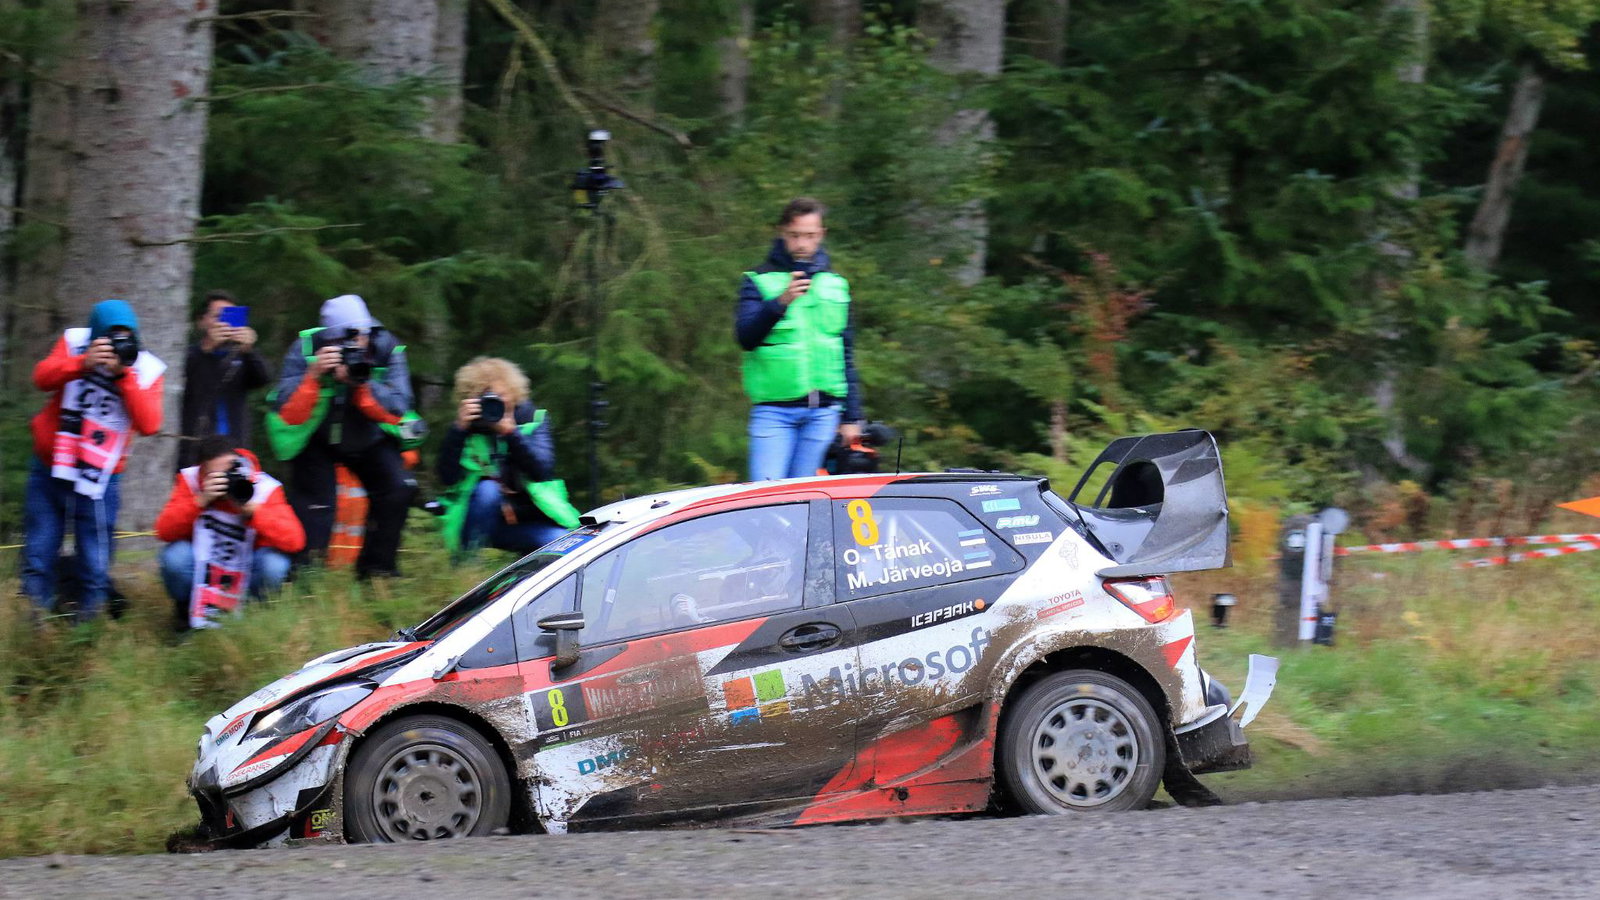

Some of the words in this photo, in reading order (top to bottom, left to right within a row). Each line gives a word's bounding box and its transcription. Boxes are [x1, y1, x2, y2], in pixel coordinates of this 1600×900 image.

[847, 499, 880, 547] 8
[1014, 533, 1051, 541] NISULA
[843, 548, 867, 566] O.
[869, 538, 933, 561] Tänak
[846, 570, 874, 590] M.
[878, 557, 964, 585] Järveoja
[1047, 589, 1082, 605] TOYOTA
[547, 688, 569, 727] 8
[569, 730, 582, 738] FIA
